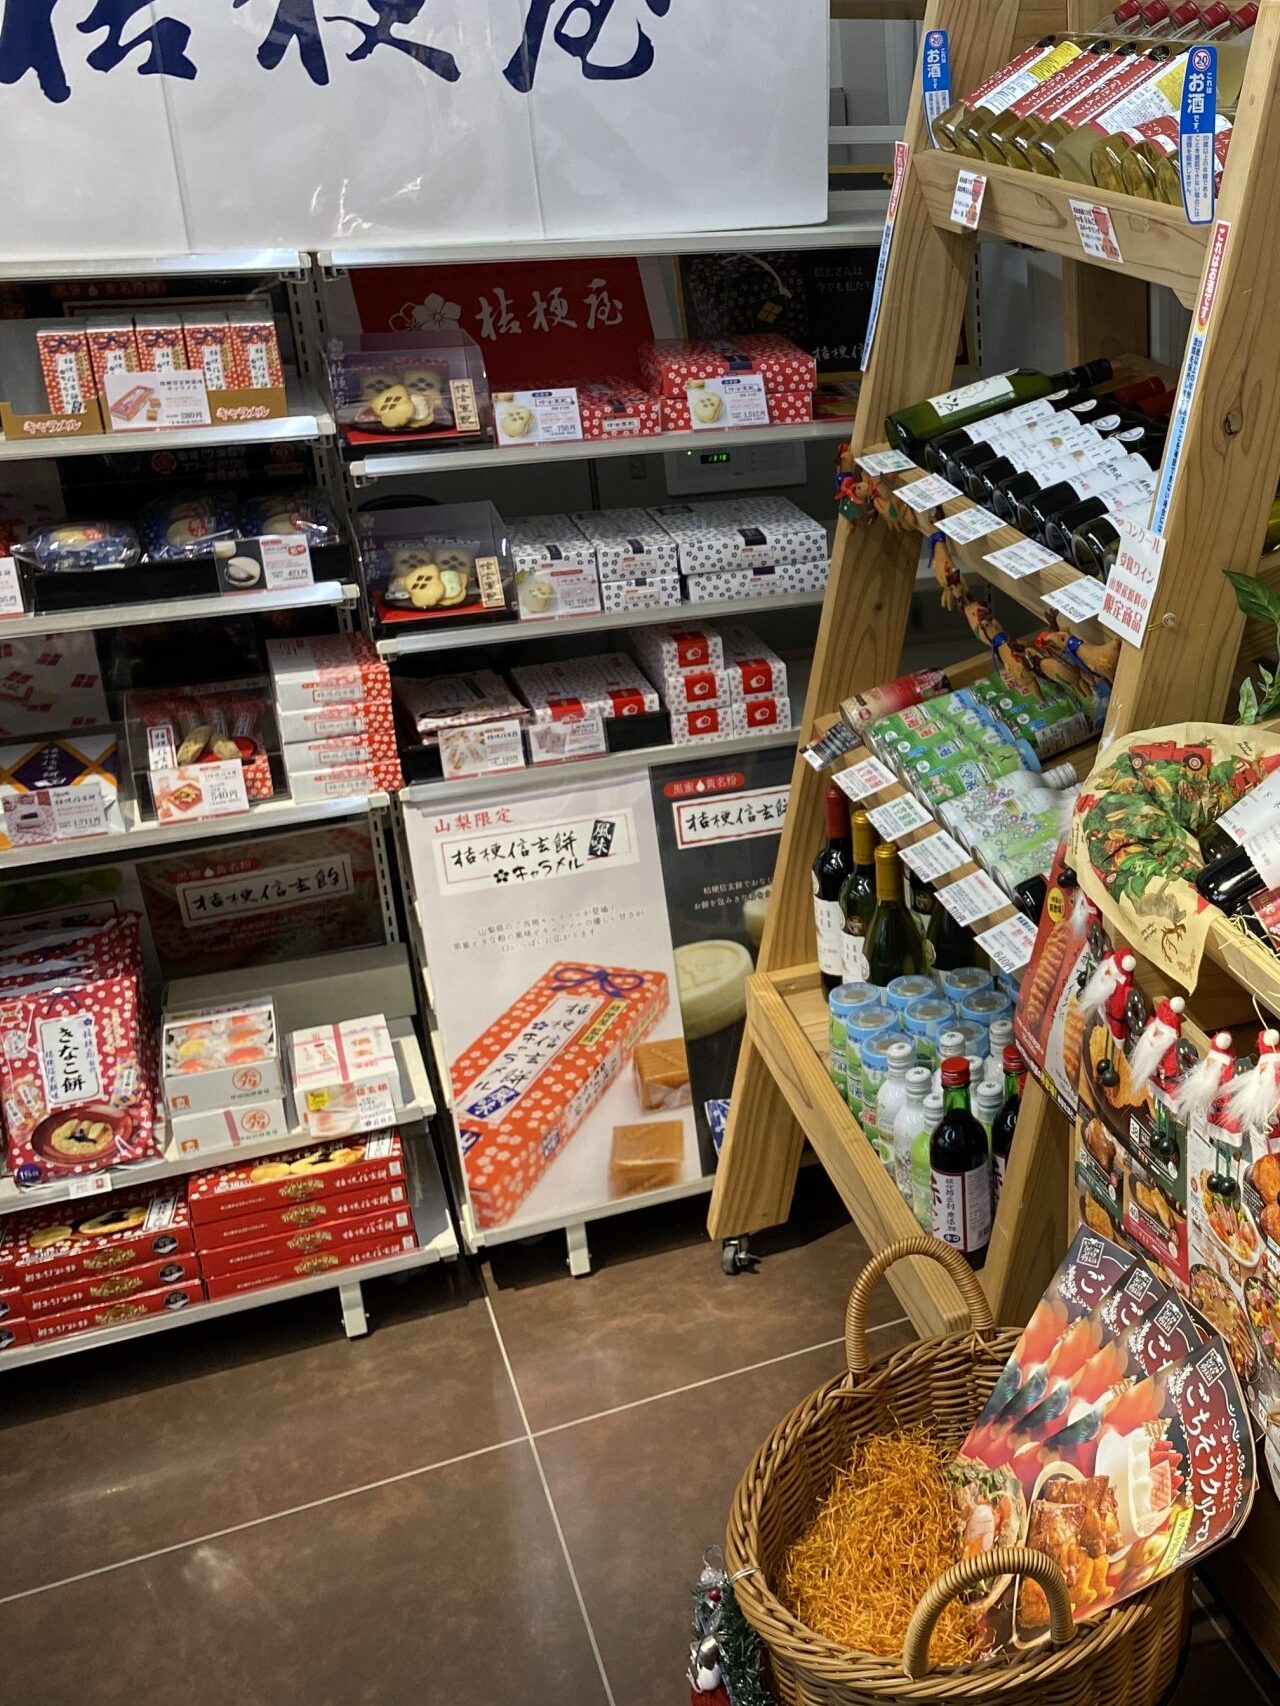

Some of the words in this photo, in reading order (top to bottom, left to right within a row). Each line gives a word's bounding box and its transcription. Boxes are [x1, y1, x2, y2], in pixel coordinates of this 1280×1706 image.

[476, 278, 625, 341] 桔梗屋
[1125, 520, 1160, 554] コンクール
[1119, 552, 1154, 584] 受賞ワイン
[1102, 592, 1143, 634] 限定商品
[434, 808, 514, 834] 山梨限定
[450, 830, 578, 868] 桔梗信玄餅
[590, 820, 615, 857] 風味
[512, 856, 585, 881] キャラメル
[58, 1027, 86, 1093] きなこ餅
